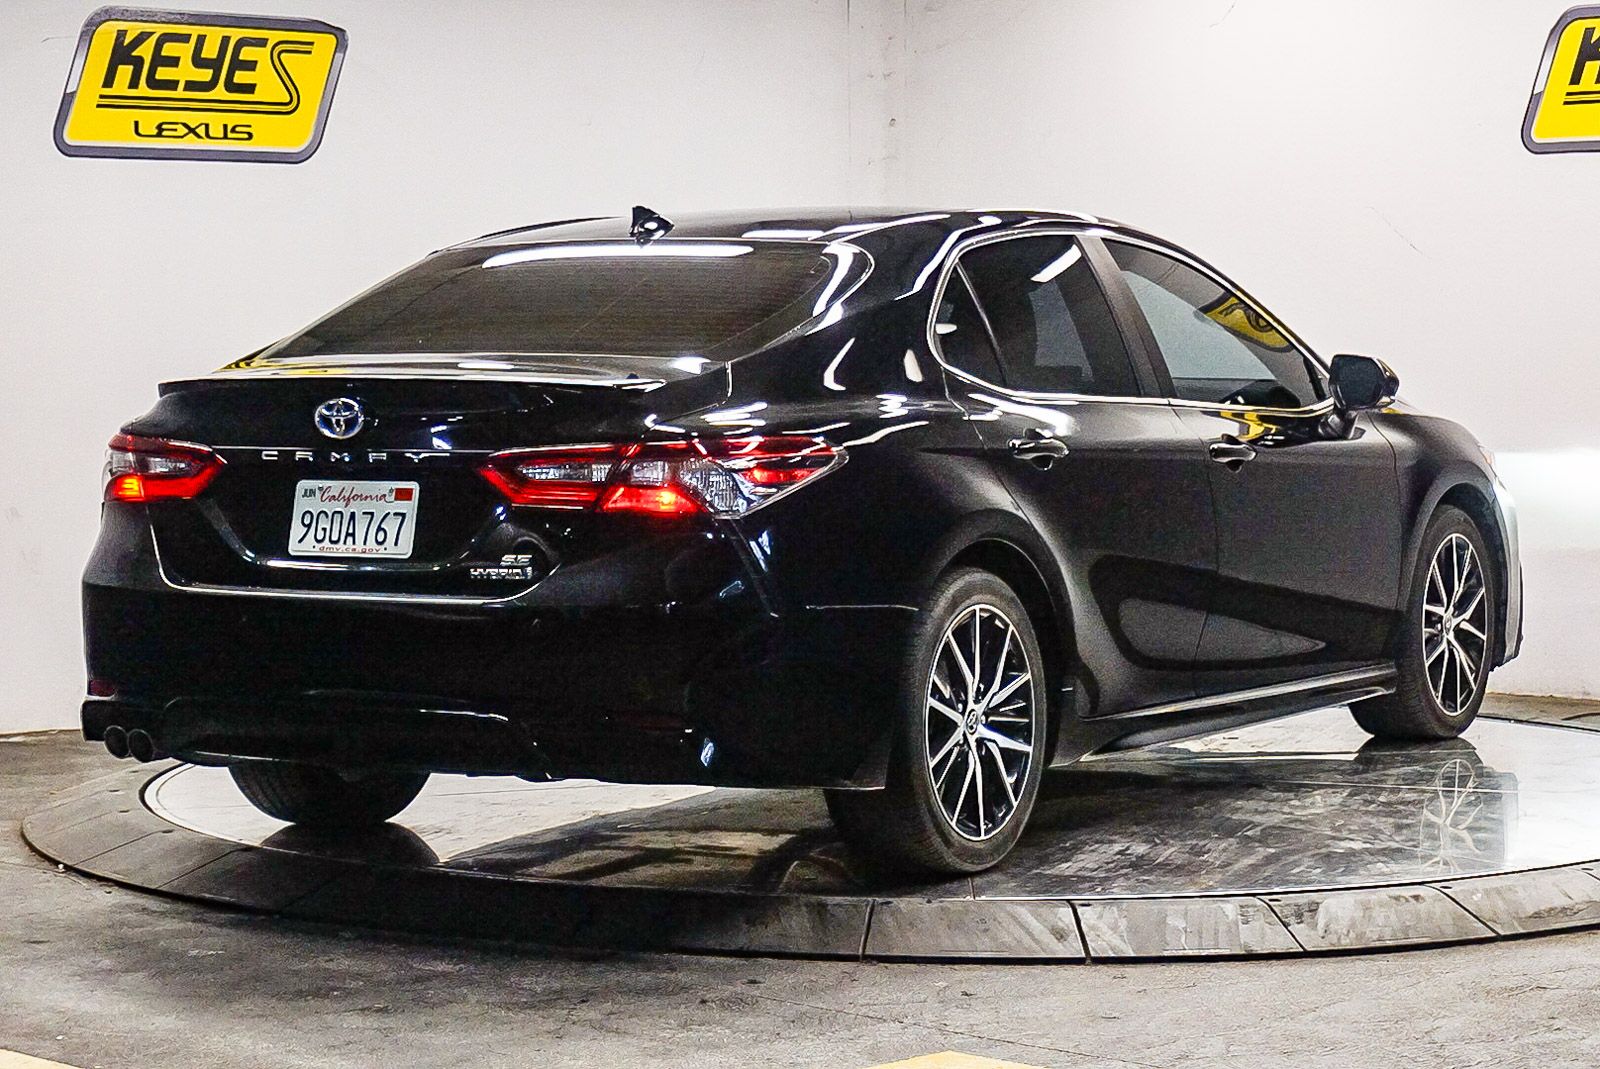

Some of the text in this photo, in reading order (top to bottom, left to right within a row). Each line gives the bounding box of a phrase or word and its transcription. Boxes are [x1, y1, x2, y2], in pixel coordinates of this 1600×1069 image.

[97, 29, 314, 115] KEYES
[133, 120, 254, 141] LEXUS
[301, 488, 316, 499] JUN
[320, 485, 389, 508] California
[297, 509, 408, 547] 9GOA767
[318, 545, 382, 554] dmv.ca.gov
[500, 554, 532, 567] SE
